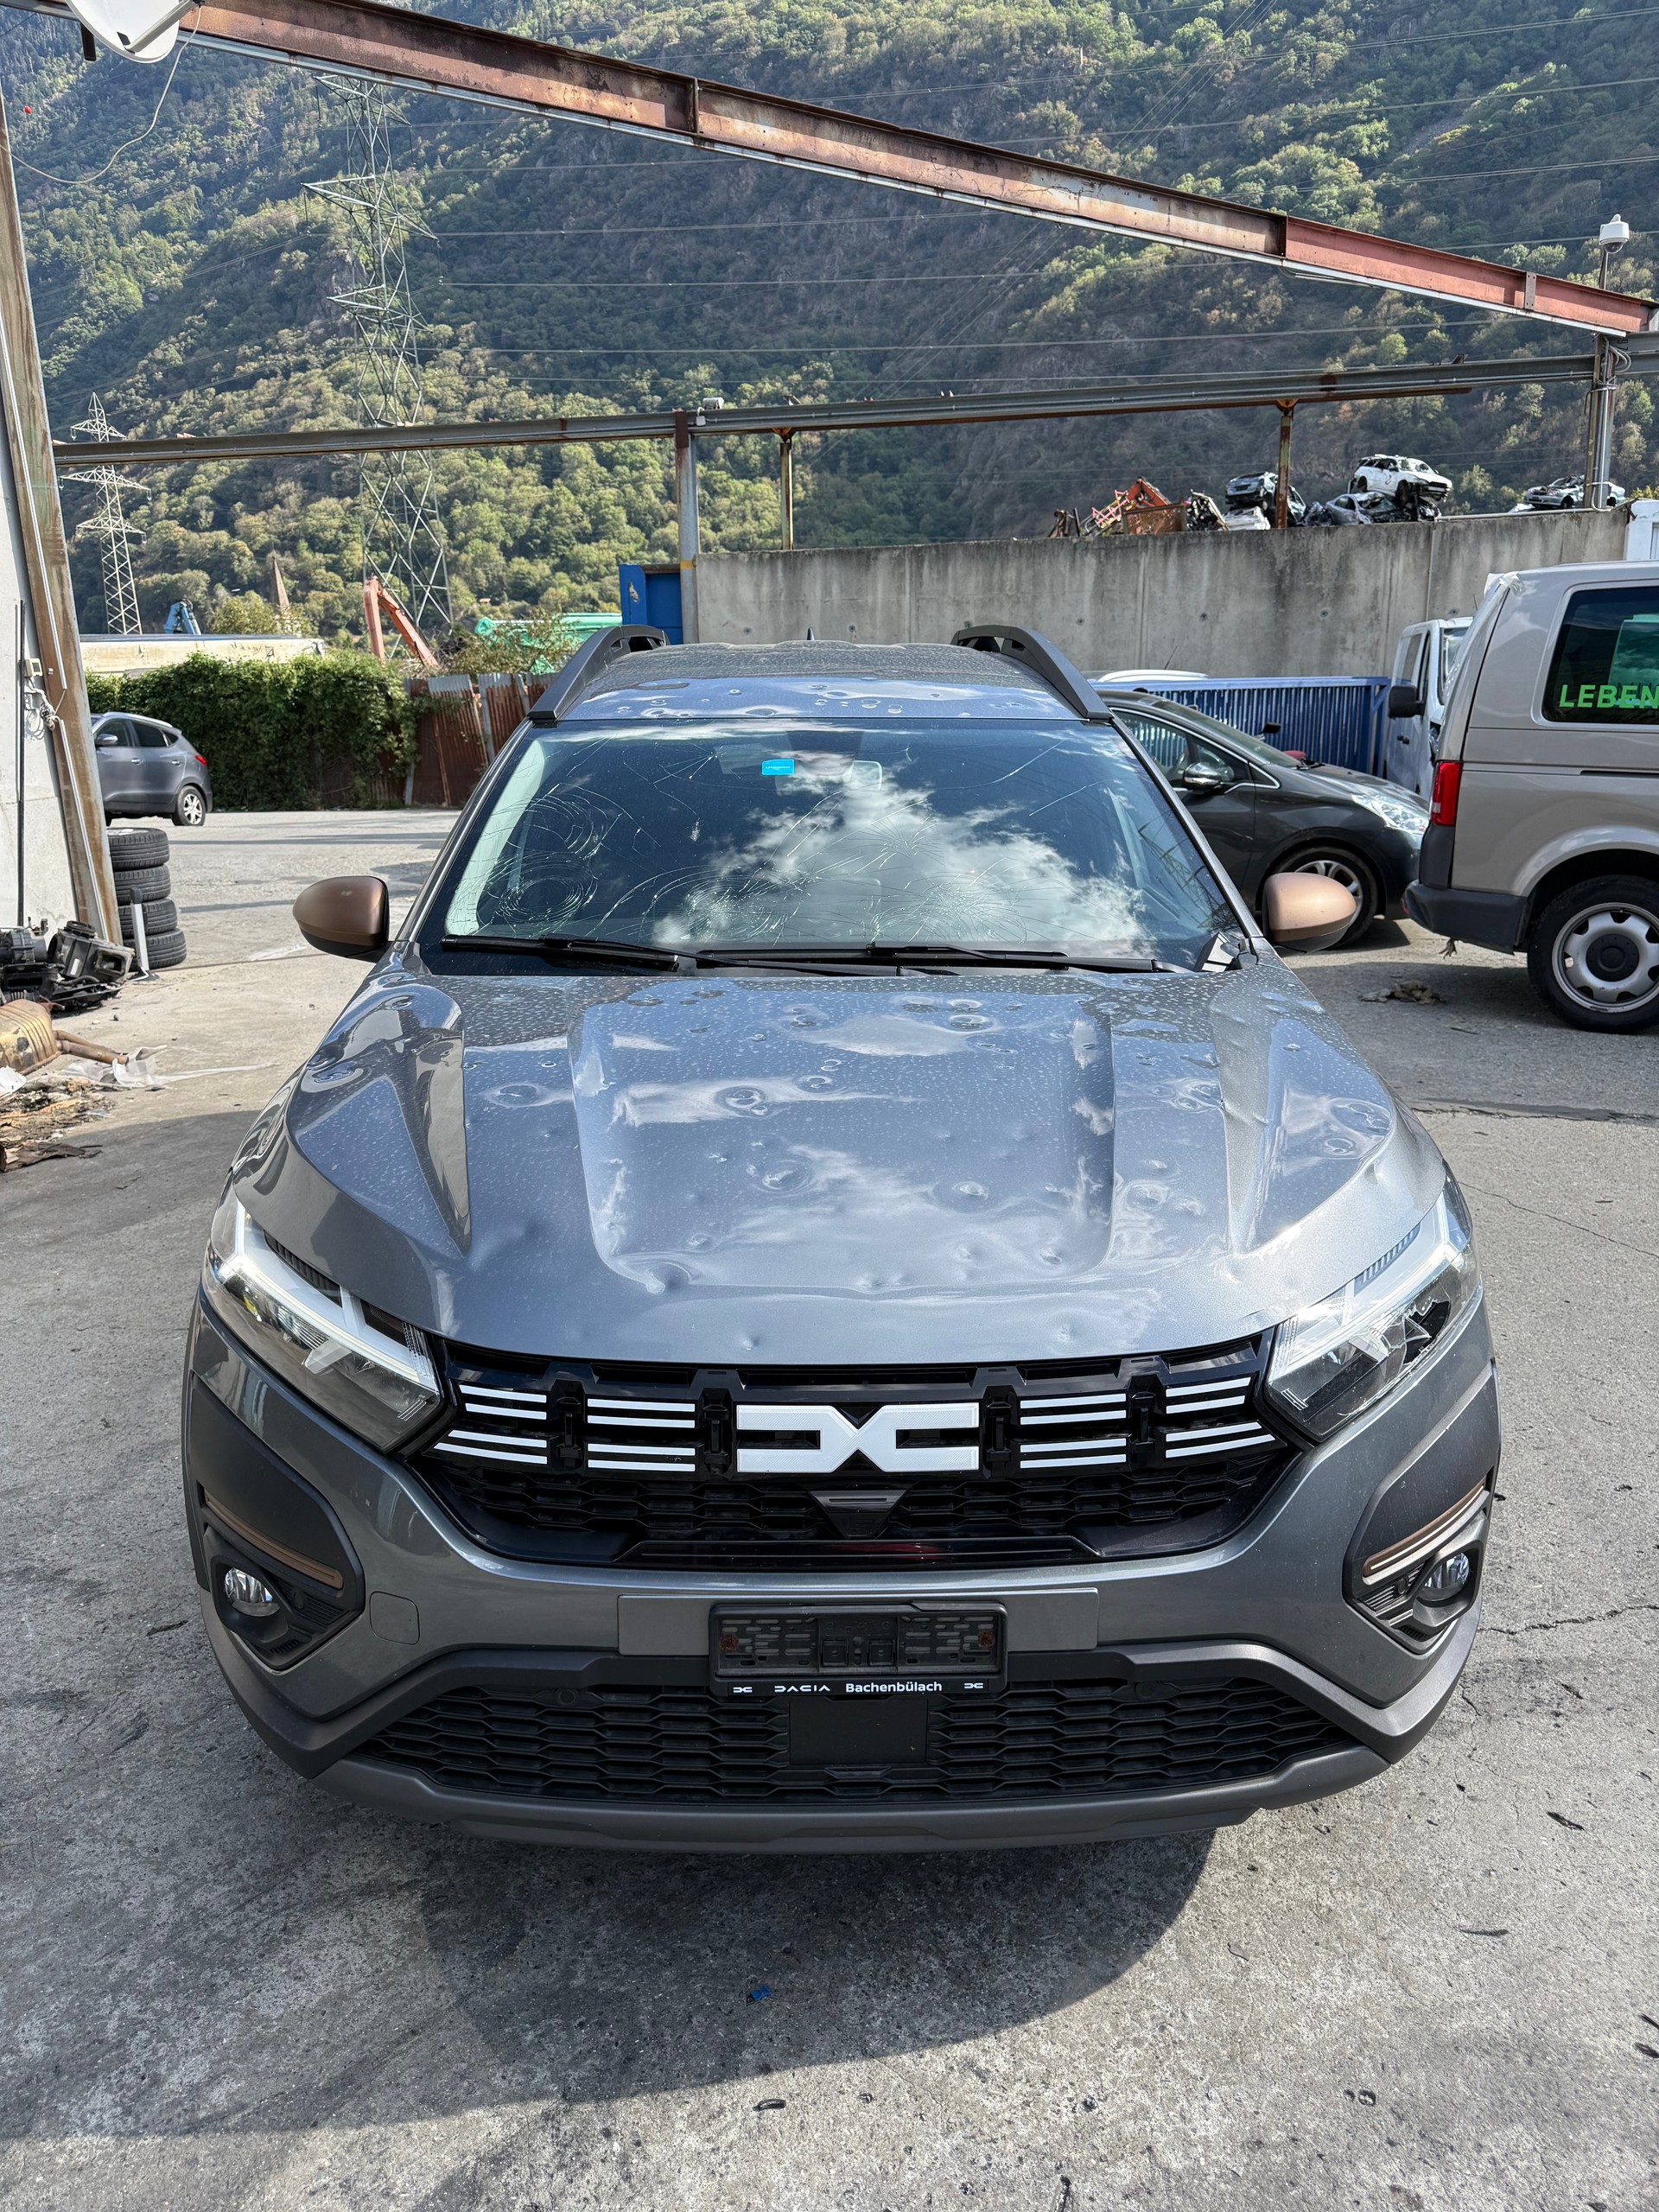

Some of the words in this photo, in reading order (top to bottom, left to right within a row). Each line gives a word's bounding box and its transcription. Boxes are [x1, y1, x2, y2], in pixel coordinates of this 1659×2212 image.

[1559, 684, 1659, 709] LEBEN
[774, 1684, 830, 1693] DACIA
[845, 1681, 943, 1693] Bachenbülach
